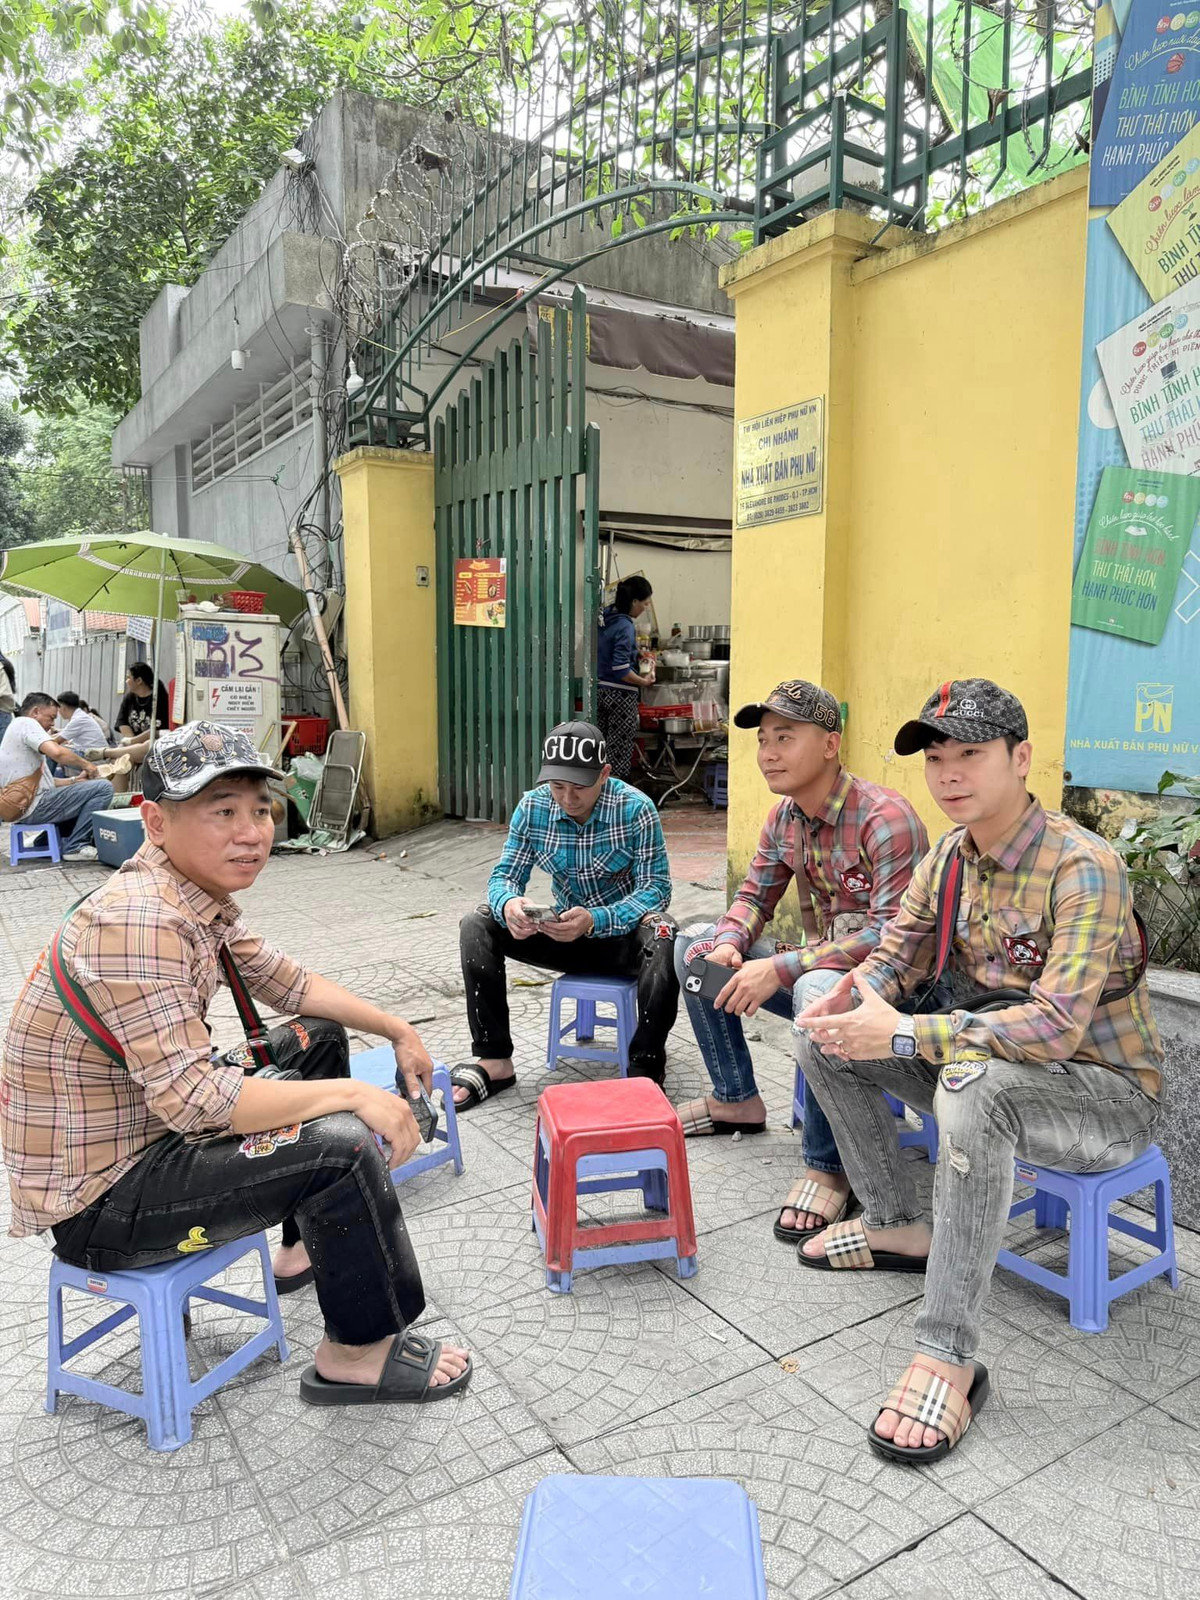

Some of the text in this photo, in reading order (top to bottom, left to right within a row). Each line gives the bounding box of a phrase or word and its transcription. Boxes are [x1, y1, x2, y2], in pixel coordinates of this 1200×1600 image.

[1118, 82, 1151, 109] BÌNH
[1151, 79, 1181, 106] TĨNH
[1115, 115, 1141, 138] THƯ
[1141, 108, 1169, 136] THÁI
[1101, 144, 1135, 171] HẠNH
[1157, 239, 1190, 275] BÌNH
[1129, 394, 1161, 424] BÌNH
[1161, 376, 1191, 403] TĨNH
[1139, 415, 1165, 443] THƯ
[1165, 399, 1196, 428] THÁI
[758, 427, 798, 450] CHI NHÁNH
[742, 462, 753, 487] NHÀ
[775, 452, 788, 481] BẢN
[790, 453, 804, 480] PHỤ
[806, 446, 816, 473] NỮ
[1092, 560, 1114, 579] THƯ
[1113, 562, 1135, 584] THÁI
[1082, 579, 1159, 612] HẠNH PHÚC HƠN
[221, 684, 234, 692] CẤM
[813, 703, 836, 728] 56
[952, 709, 984, 718] GUCCI
[1070, 737, 1091, 748] NHÀ
[1094, 737, 1120, 750] XUẤT
[1122, 738, 1145, 751] BẢN
[1147, 742, 1169, 755] PHỤ
[1172, 741, 1189, 753] NỮ
[99, 827, 118, 843] PEPSI
